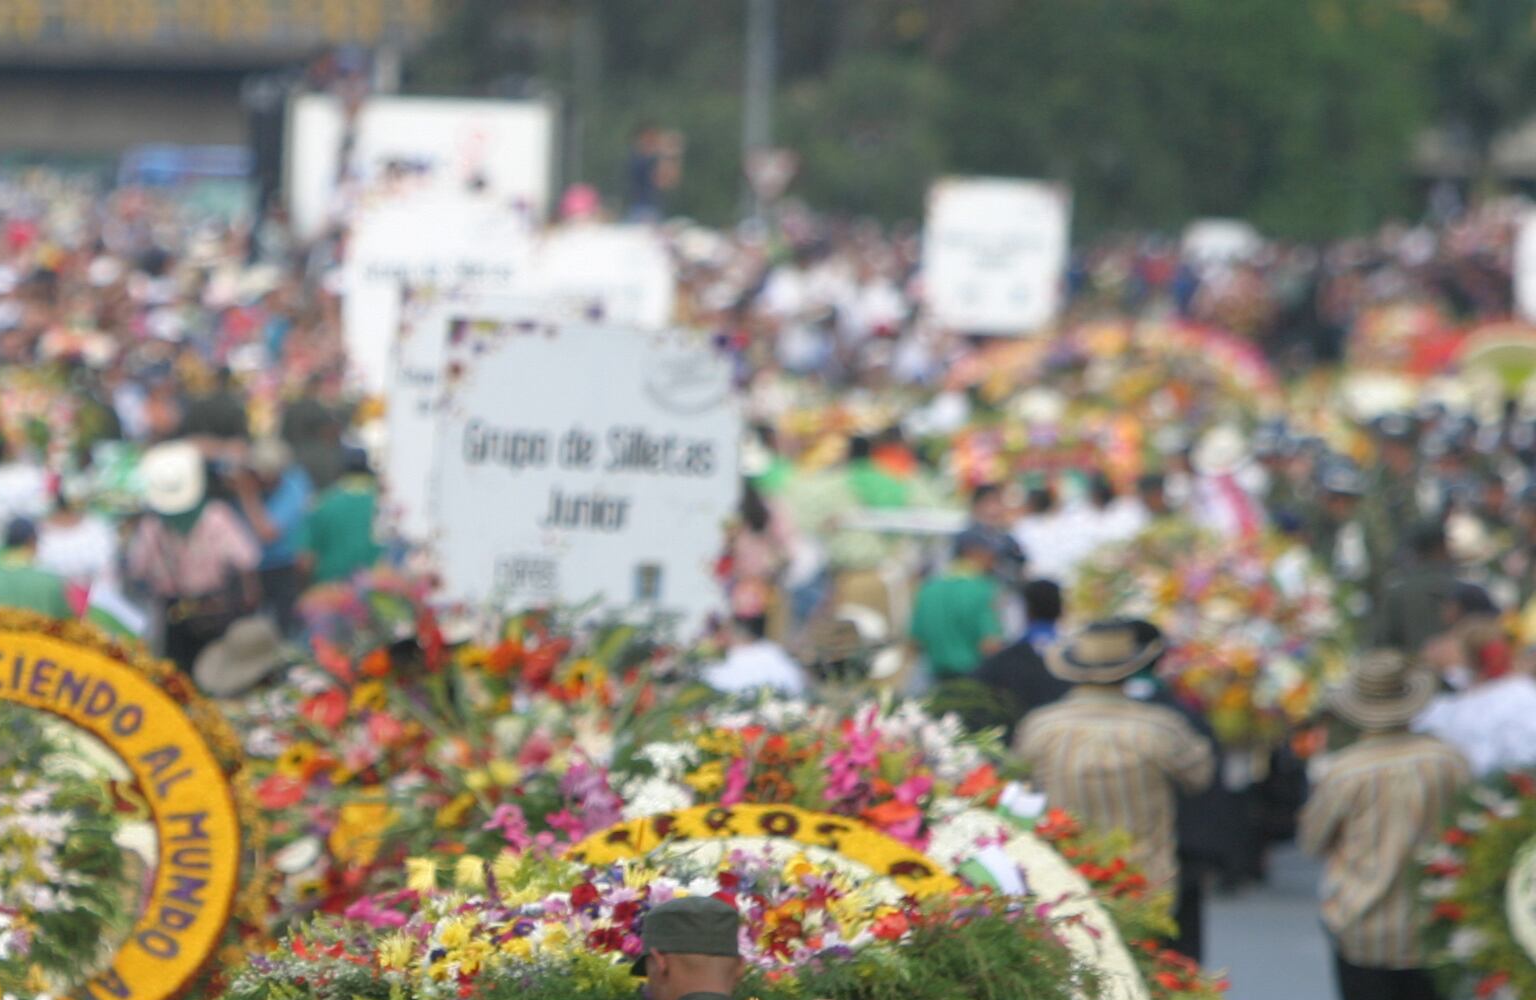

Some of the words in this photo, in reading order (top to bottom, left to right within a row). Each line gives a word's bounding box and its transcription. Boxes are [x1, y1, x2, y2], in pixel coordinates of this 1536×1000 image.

[465, 419, 547, 470] Grupo
[559, 423, 596, 468] de
[606, 425, 715, 476] Silletas
[538, 485, 632, 531] Junior
[139, 746, 193, 797] AL
[138, 811, 211, 959] MUNDO
